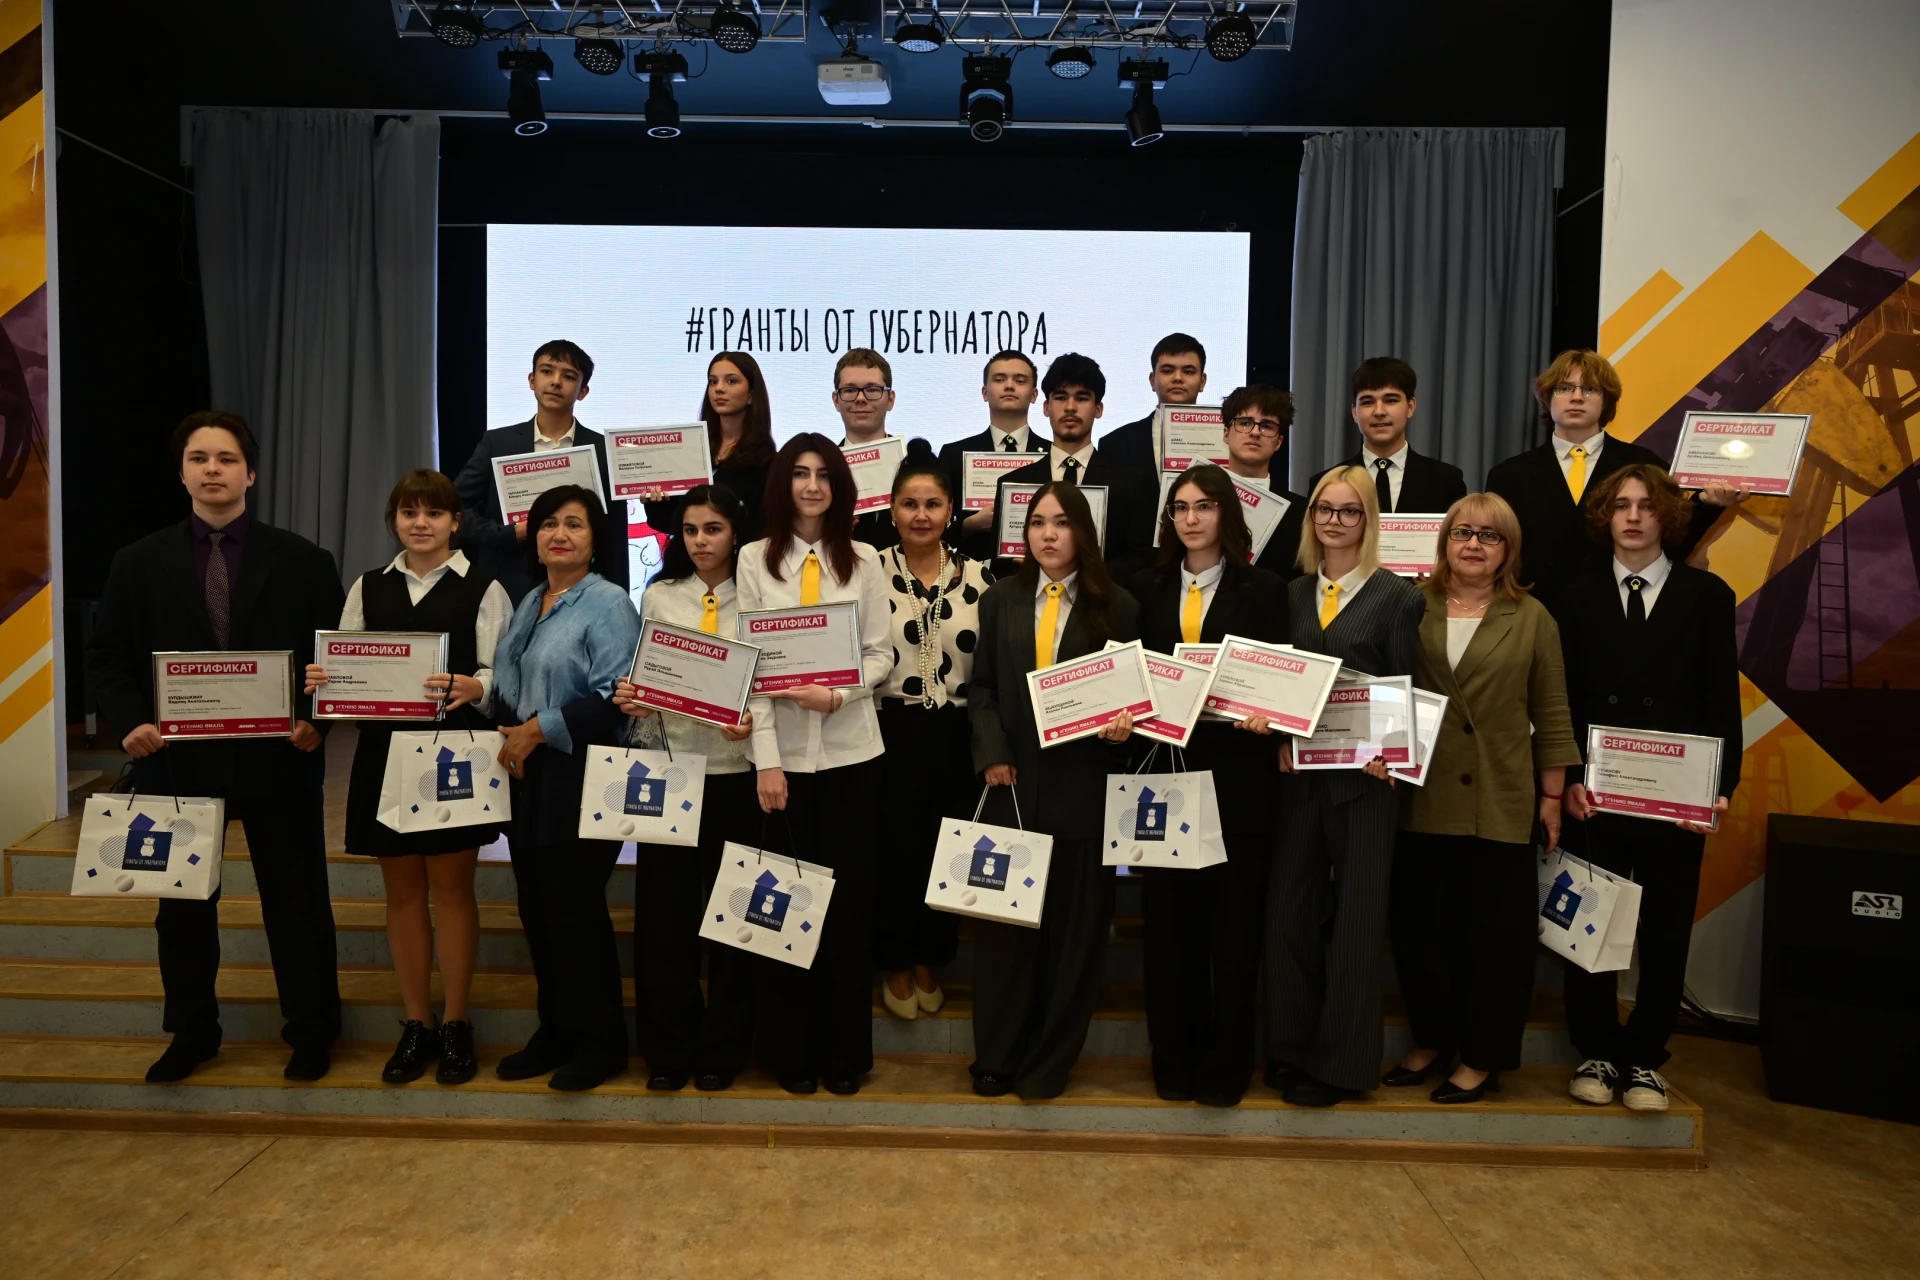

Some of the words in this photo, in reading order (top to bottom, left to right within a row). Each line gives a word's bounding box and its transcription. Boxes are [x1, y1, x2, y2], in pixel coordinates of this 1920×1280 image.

[685, 306, 809, 354] #ГРАНТЫ
[824, 308, 855, 354] ОТ
[869, 309, 1048, 355] ГУБЕРНАТОРА
[1173, 413, 1223, 422] СЕРТИФИК
[1697, 423, 1772, 435] СЕРТИФИКАТ
[618, 434, 680, 445] СЕРТИФИКАТ
[846, 451, 877, 463] ФИКАТ
[505, 458, 567, 474] СЕРТИФИКАТ
[752, 616, 824, 631] СЕРТИФИКАТ
[331, 644, 408, 655] СЕРТИФИКАТ
[654, 632, 725, 659] СЕРТИФИКАТ
[1233, 649, 1303, 671] СЕРТИФИКАТ
[170, 663, 254, 674] СЕРТИФИКАТ
[1042, 660, 1111, 687] СЕРТИФИКАТ
[1147, 663, 1181, 678] ФИКАТ
[666, 696, 683, 705] ЯМАЛА
[1602, 738, 1682, 755] СЕРТИФИКАТ
[1853, 908, 1900, 917] AUDIO
